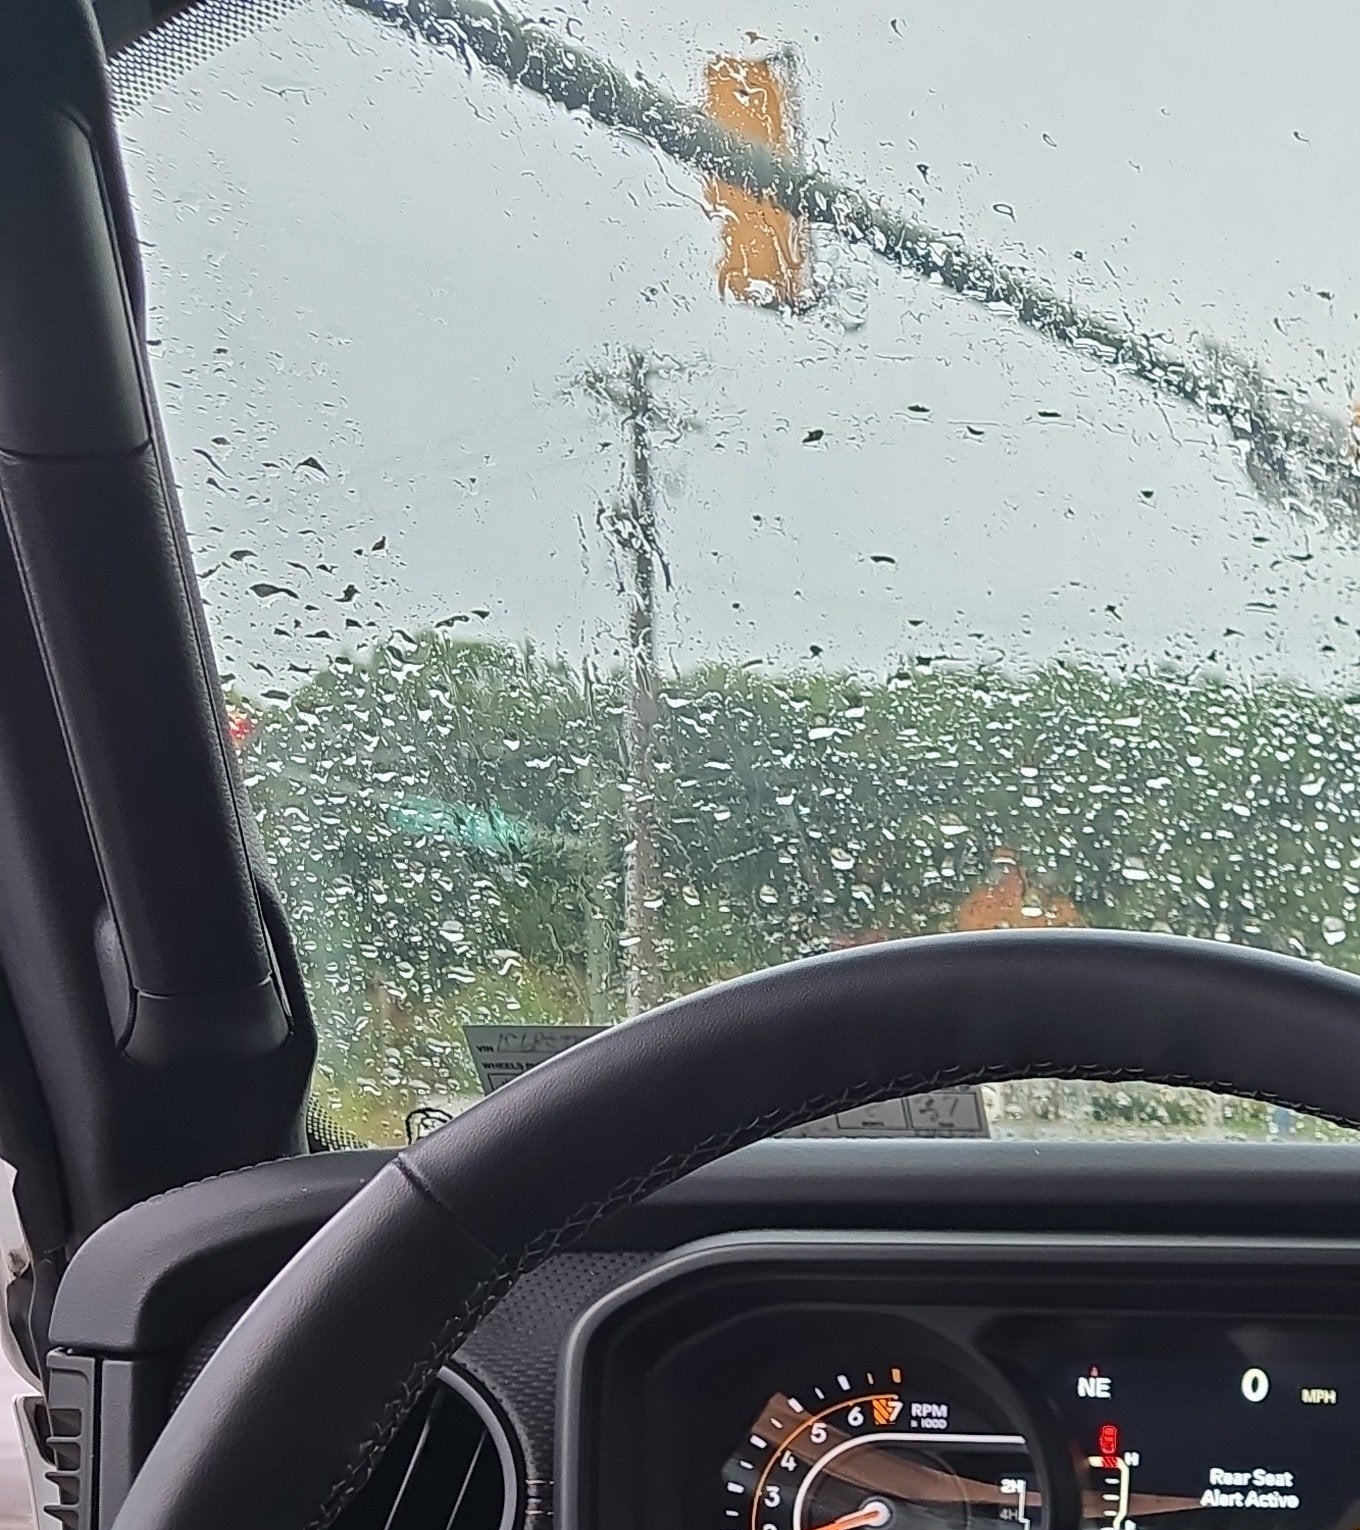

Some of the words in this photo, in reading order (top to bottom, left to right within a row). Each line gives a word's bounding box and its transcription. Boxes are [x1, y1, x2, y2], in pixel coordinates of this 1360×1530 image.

[1077, 1377, 1111, 1399] NE
[1241, 1367, 1269, 1402] 0
[1301, 1388, 1337, 1404] MPH
[848, 1406, 864, 1427] 6
[888, 1401, 904, 1422] 7
[911, 1402, 948, 1418] RPM
[810, 1422, 827, 1443] 5
[920, 1417, 948, 1430] 1000
[780, 1450, 797, 1472] 4
[1124, 1451, 1140, 1467] H
[1000, 1478, 1025, 1494] 2H
[1209, 1467, 1251, 1486] Rear
[1252, 1468, 1294, 1487] Seat
[764, 1485, 780, 1508] 3
[1200, 1489, 1244, 1508] Alert
[1244, 1490, 1300, 1509] Active
